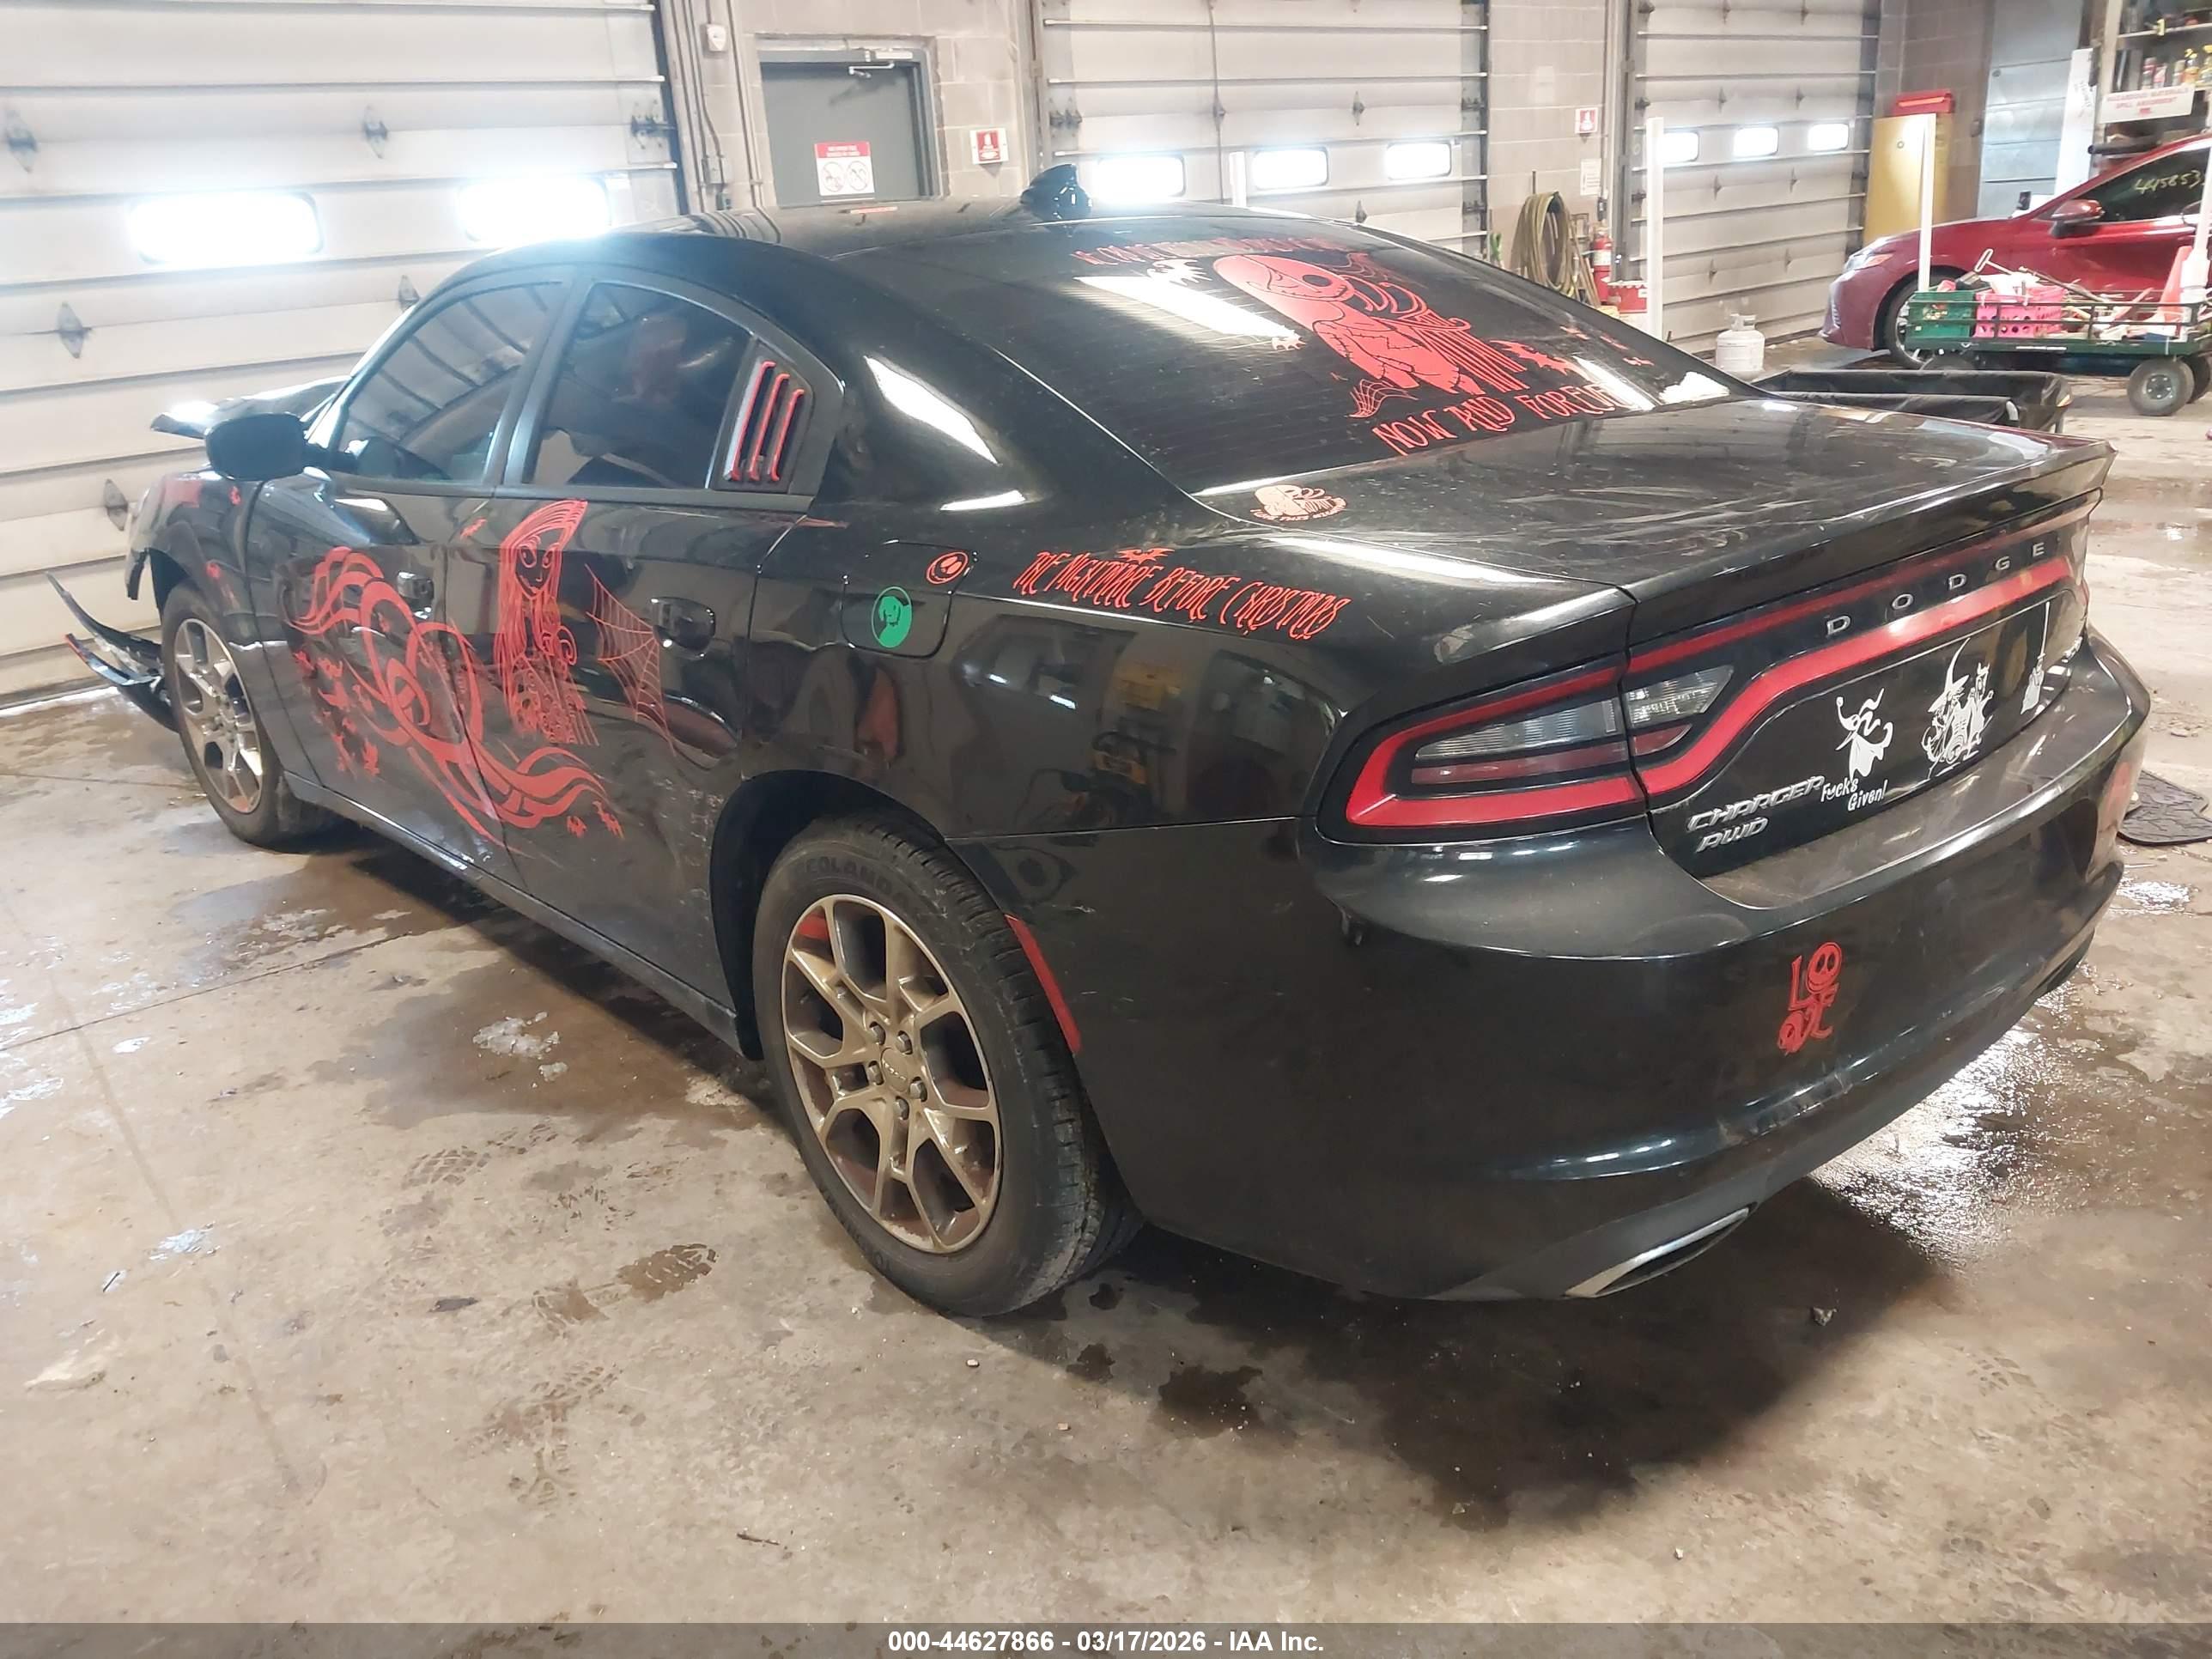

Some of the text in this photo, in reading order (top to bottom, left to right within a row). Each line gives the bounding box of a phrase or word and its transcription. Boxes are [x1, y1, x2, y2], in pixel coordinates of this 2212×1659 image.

[1372, 383, 1633, 456] NOW AND FOREVE
[1012, 551, 1352, 640] THE NIGHTMARE BEFORE CHRISTMAS
[1826, 542, 2045, 635] DODGE
[1686, 775, 1826, 833] CHARGER
[1820, 777, 1859, 802] Fucks
[1847, 780, 1888, 811] Given!
[1695, 817, 1769, 854] AWD
